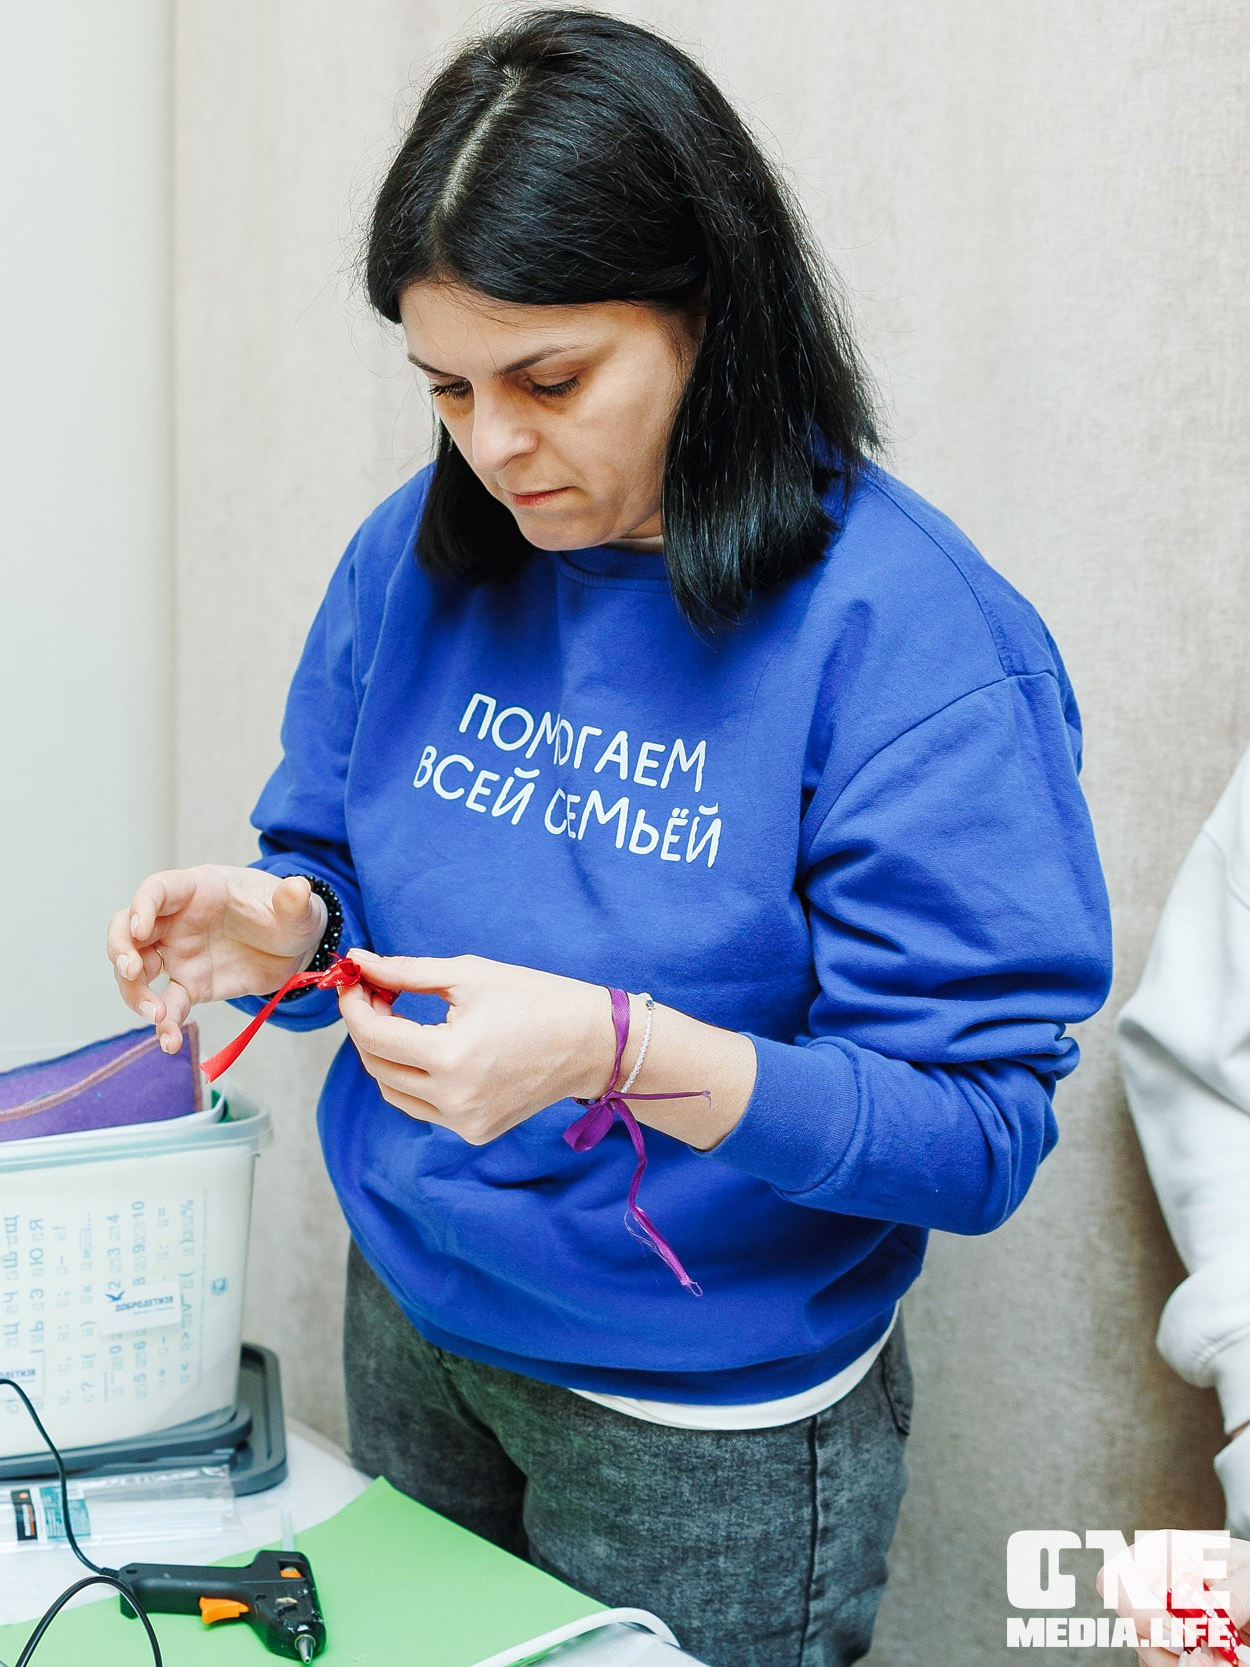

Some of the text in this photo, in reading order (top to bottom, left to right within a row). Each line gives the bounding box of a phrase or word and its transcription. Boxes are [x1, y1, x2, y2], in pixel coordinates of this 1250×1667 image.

[459, 693, 706, 792] ПОМОГАЕМ
[413, 746, 722, 868] ВСЕЙ СЕМЬЁЙ
